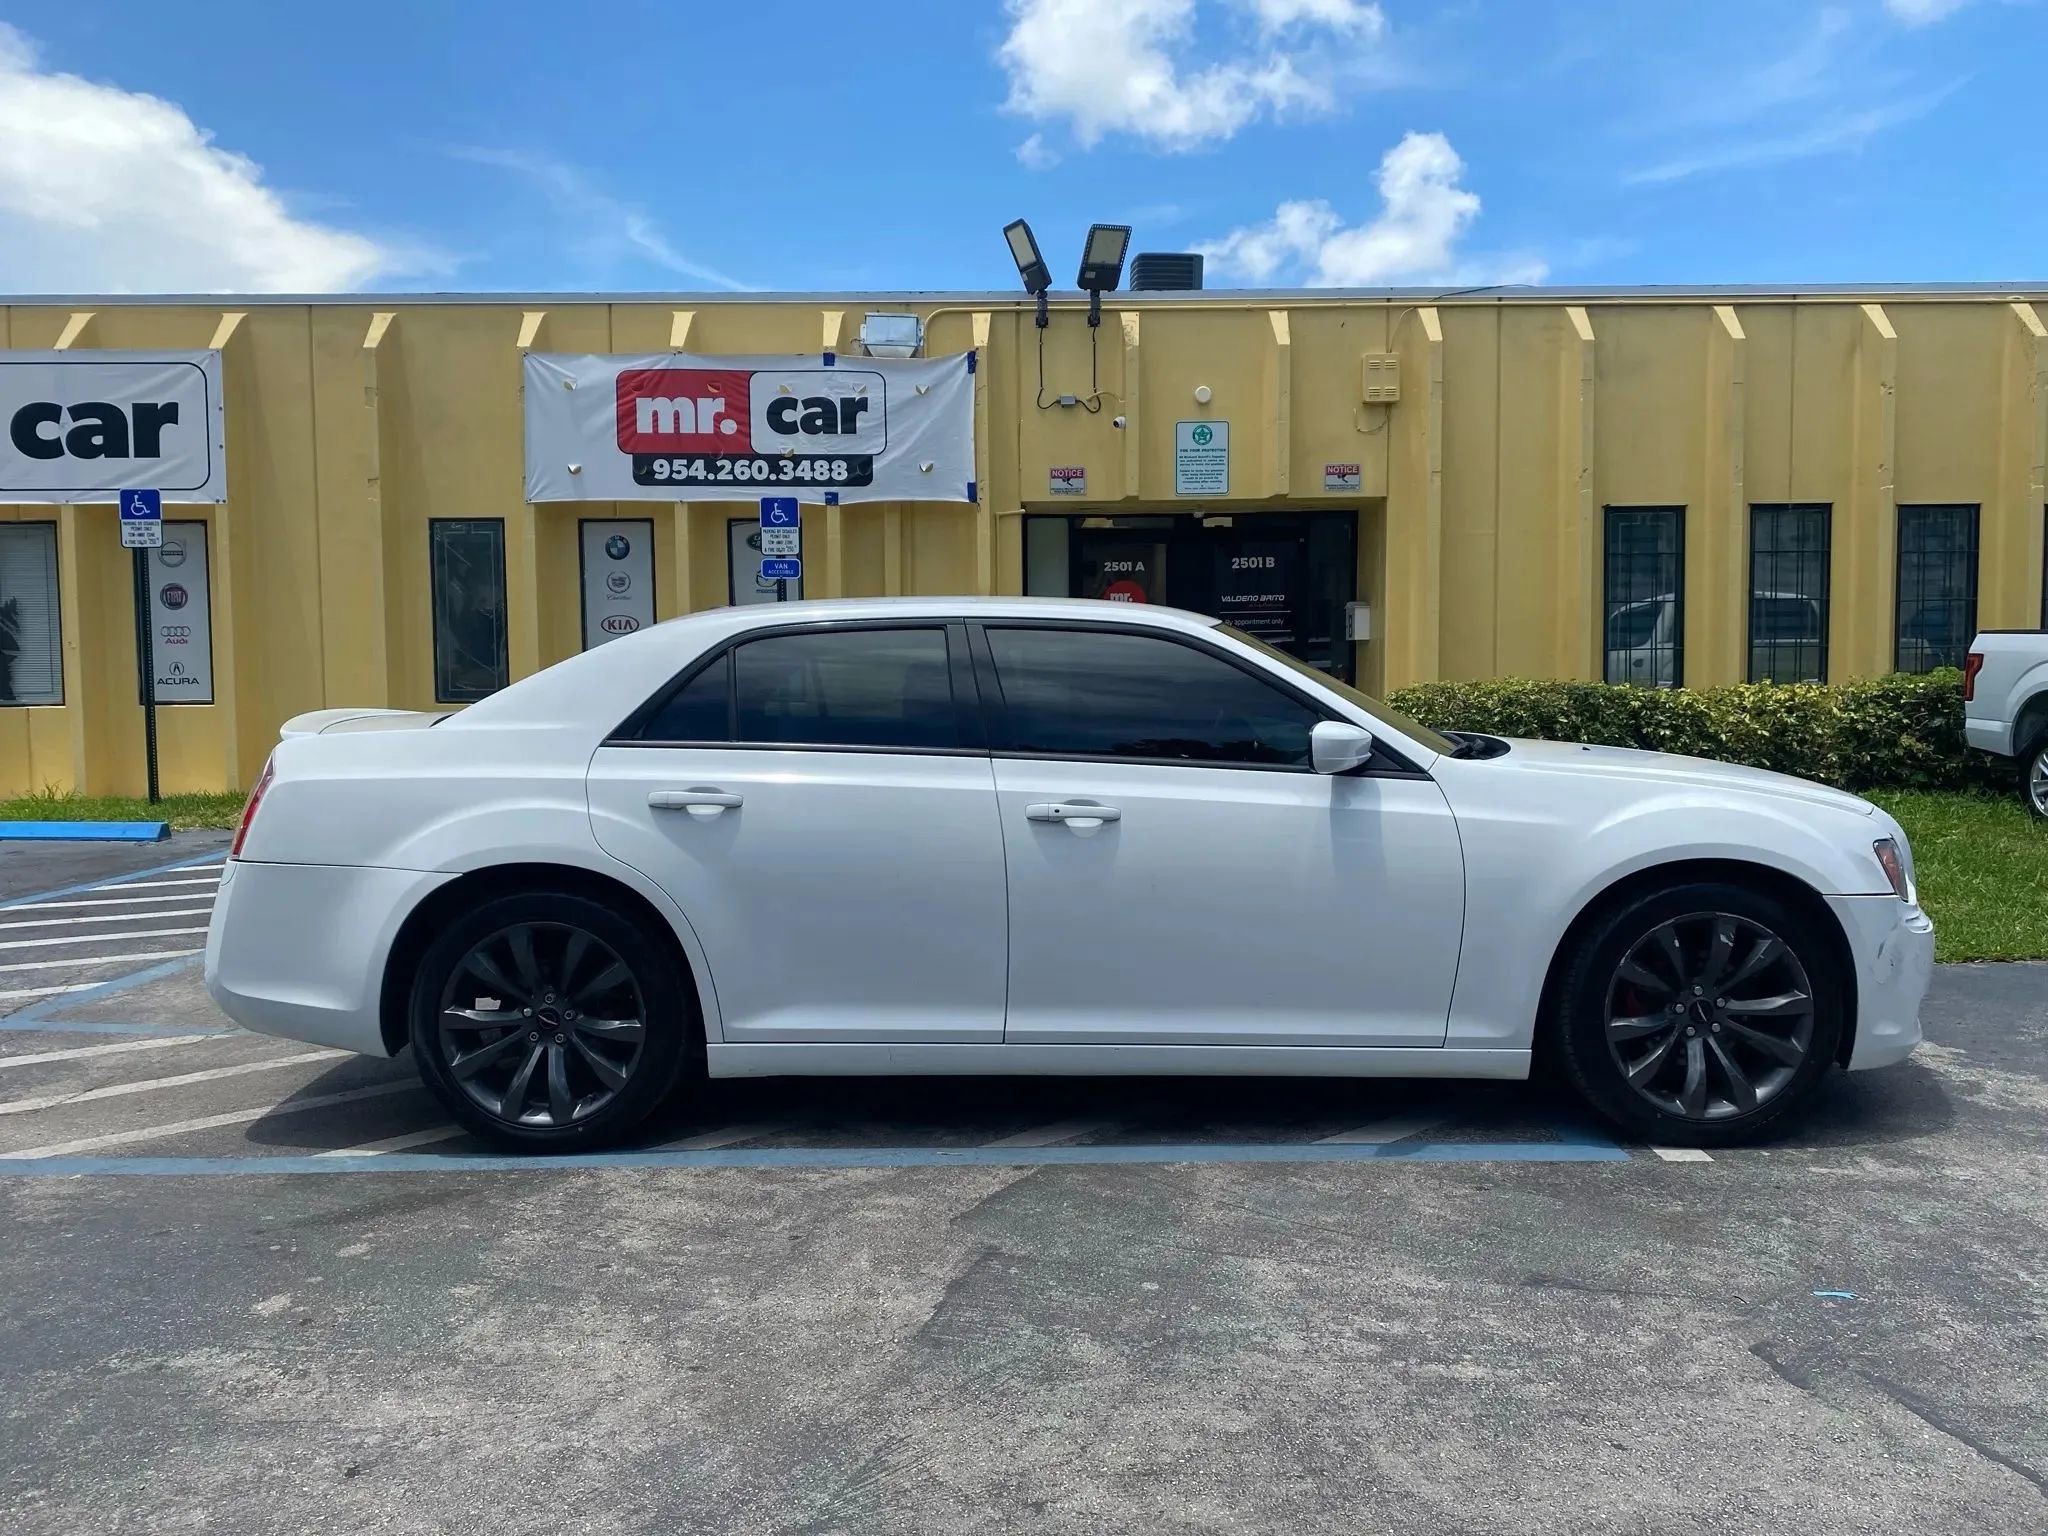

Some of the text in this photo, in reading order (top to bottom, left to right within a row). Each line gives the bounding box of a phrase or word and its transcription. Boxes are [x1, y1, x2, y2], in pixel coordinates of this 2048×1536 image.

[636, 396, 869, 435] mr. car
[10, 402, 179, 460] car
[652, 459, 848, 481] 954.260.3488
[1052, 469, 1083, 477] NOTICE
[1104, 561, 1145, 572] 2501 A
[1231, 557, 1276, 569] 2501 B
[166, 590, 183, 603] FIAT
[1110, 592, 1133, 603] mr.
[1259, 594, 1285, 602] BRITO
[607, 619, 633, 630] KIA
[1234, 618, 1271, 627] appointment
[1271, 618, 1284, 626] only
[157, 677, 199, 685] ACURA
